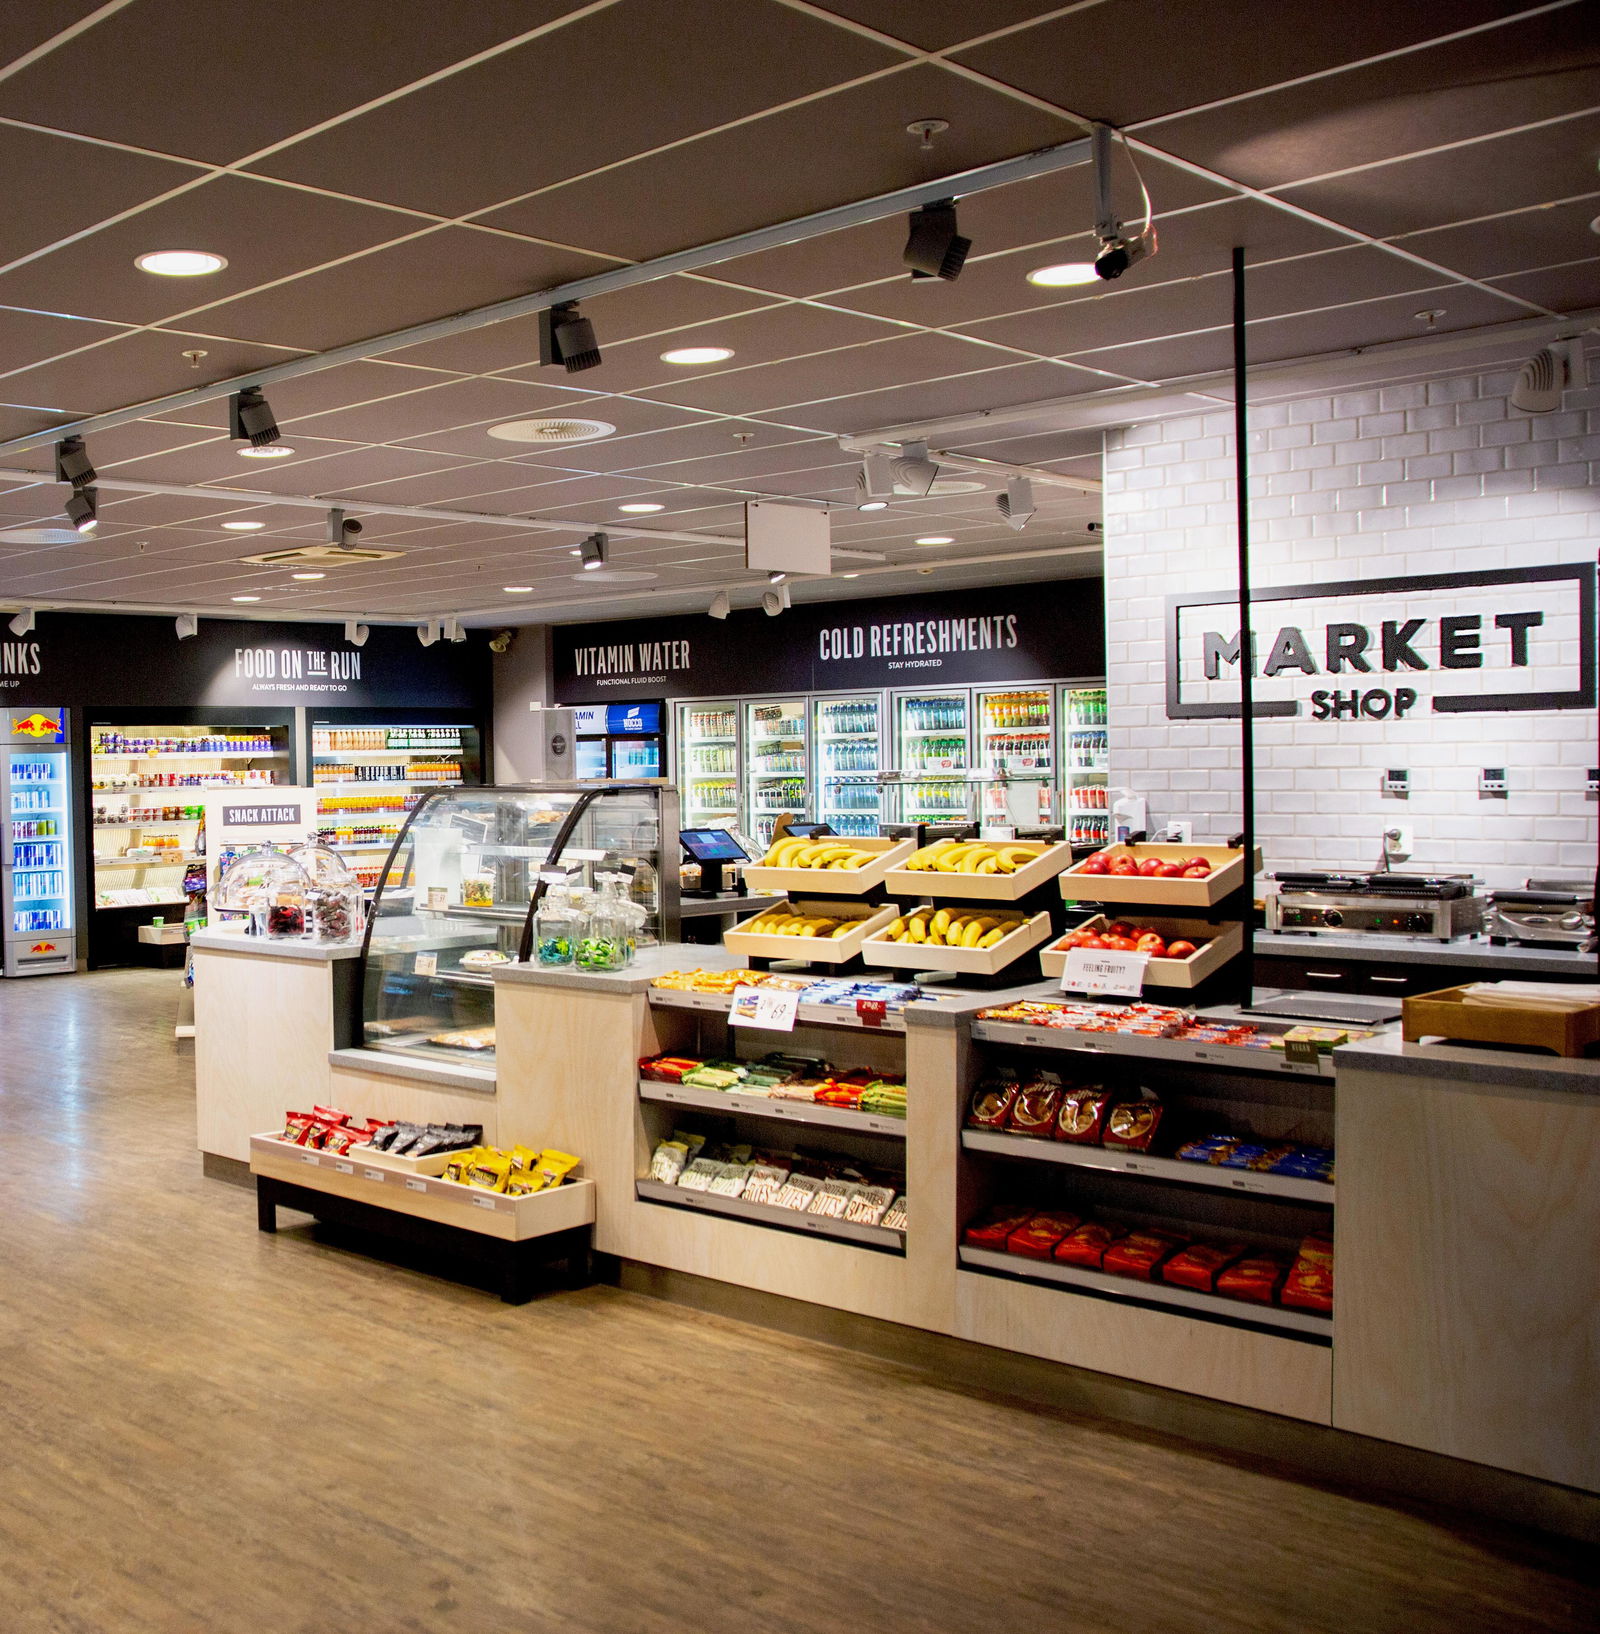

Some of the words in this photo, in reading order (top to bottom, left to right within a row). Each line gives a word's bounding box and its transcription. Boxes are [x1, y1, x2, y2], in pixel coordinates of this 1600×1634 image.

[819, 628, 864, 661] COLD
[870, 614, 1018, 657] REFRESHMENTS
[1203, 611, 1545, 681] MARKET
[234, 648, 276, 679] FOOD
[281, 649, 302, 679] ON
[306, 651, 328, 676] THE
[331, 651, 361, 680] RUN
[575, 644, 634, 676] VITAMIN
[639, 640, 691, 672] WATER
[888, 661, 904, 670] STAY
[904, 659, 943, 669] HYDRATED
[252, 683, 276, 692] ALWAYS
[276, 683, 295, 692] FRESH
[295, 683, 309, 692] AND
[309, 684, 328, 692] READY
[329, 684, 337, 692] TO
[596, 678, 631, 687] FUNCTIONAL
[631, 676, 648, 685] FLUID
[648, 675, 668, 683] BOOST
[1311, 687, 1418, 720] SHOP
[228, 808, 259, 824] SNACK
[260, 807, 296, 822] ATTACK
[1082, 963, 1103, 973] FEELING
[1103, 964, 1126, 974] FRUITY?
